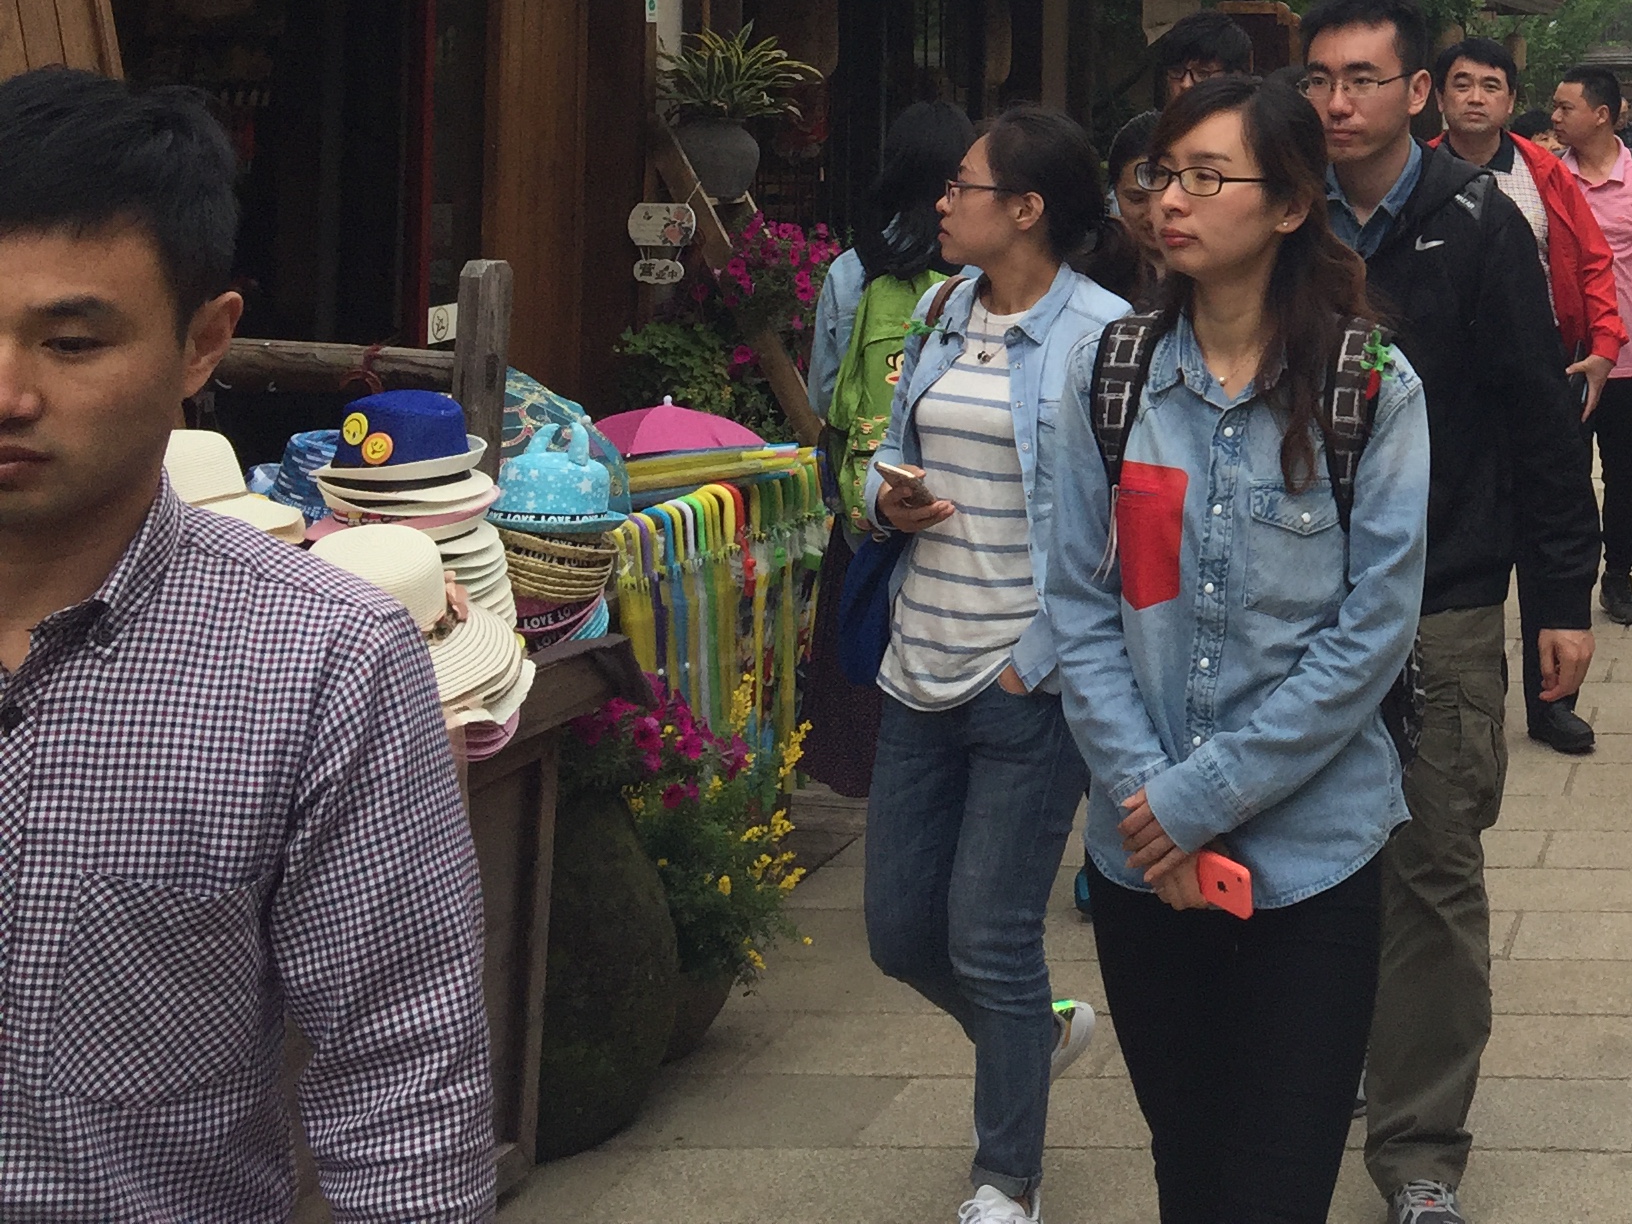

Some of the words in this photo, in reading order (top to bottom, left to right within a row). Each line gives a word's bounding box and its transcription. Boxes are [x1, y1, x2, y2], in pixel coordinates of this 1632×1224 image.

[639, 262, 678, 280] 营业中
[524, 614, 556, 629] LOVE
